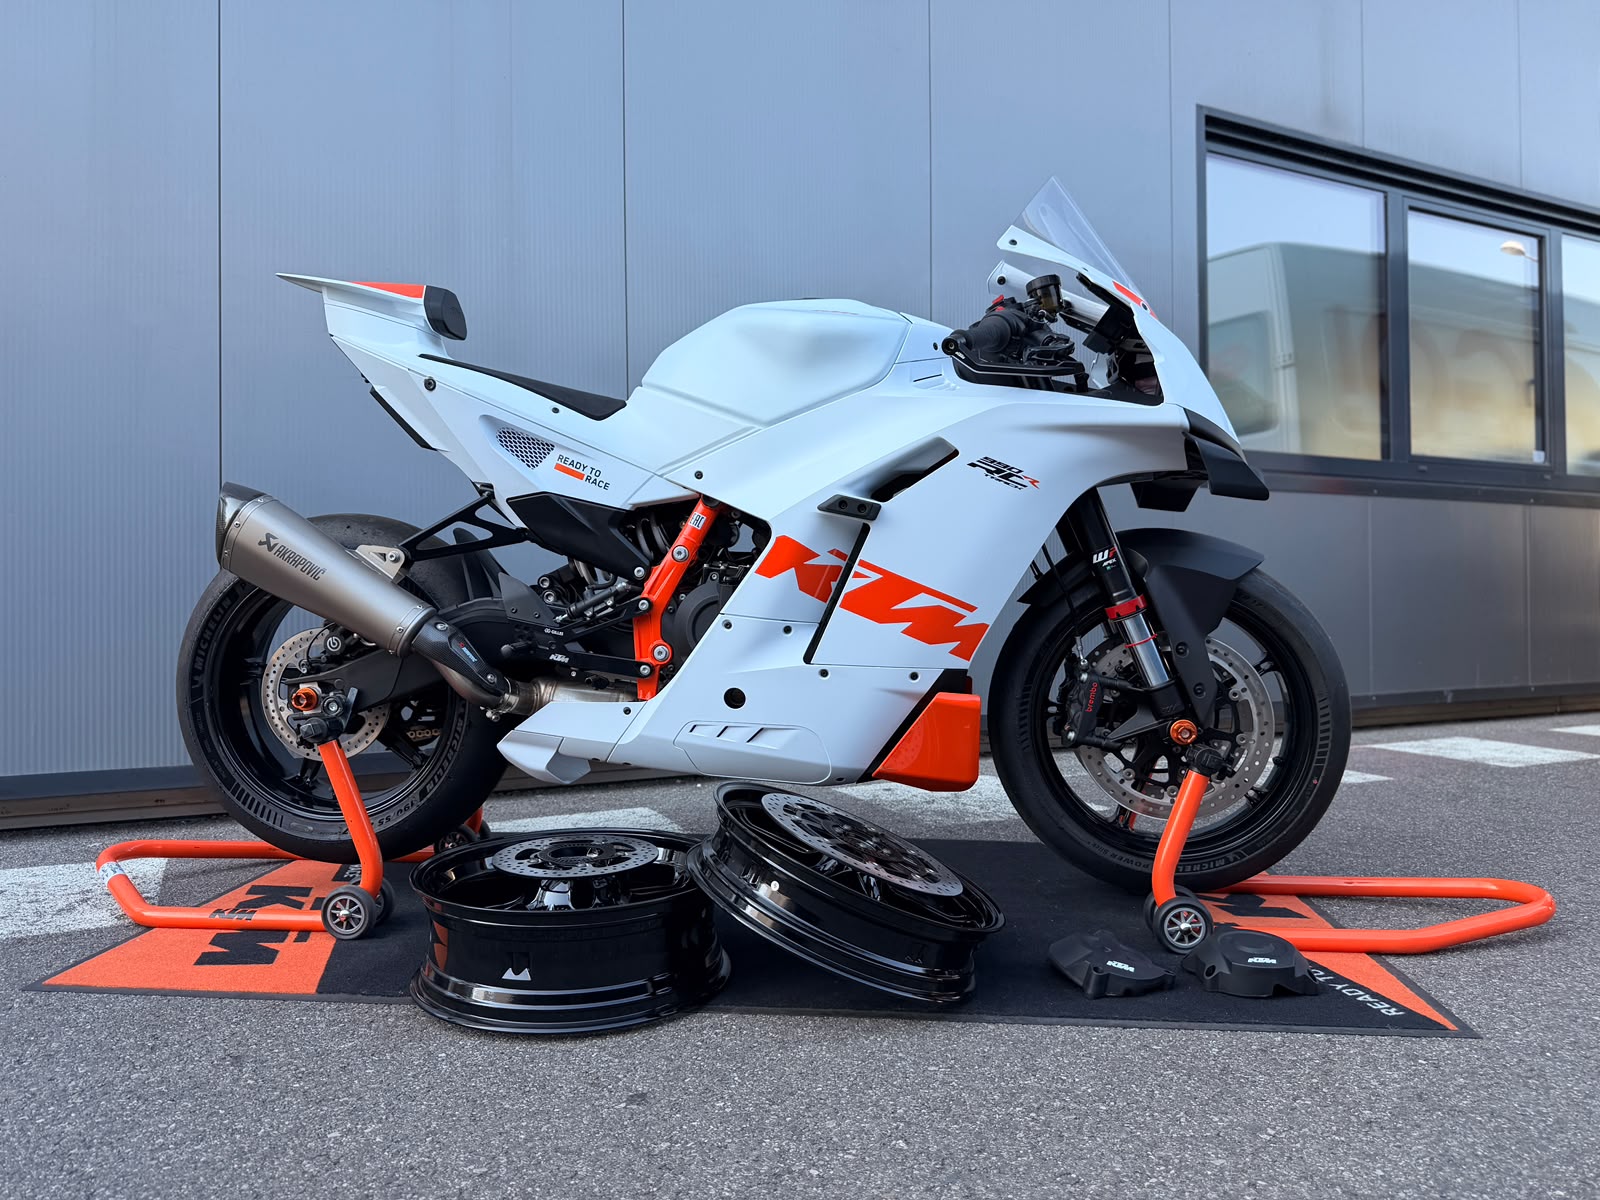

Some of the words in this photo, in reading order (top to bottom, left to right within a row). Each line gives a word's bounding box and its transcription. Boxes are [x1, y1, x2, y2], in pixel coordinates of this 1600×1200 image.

[557, 454, 588, 472] READY
[590, 466, 602, 478] TO
[584, 474, 611, 491] RACE
[754, 535, 990, 662] KTM
[194, 596, 234, 672] MICHELIN
[1085, 682, 1098, 712] brembo
[425, 717, 465, 794] MICHELIN
[1110, 853, 1150, 870] POWER
[1176, 857, 1226, 873] MICHEL
[209, 908, 259, 922] KTM
[1106, 960, 1136, 973] KTM
[1248, 957, 1278, 965] KTM
[1328, 983, 1406, 1016] READY
